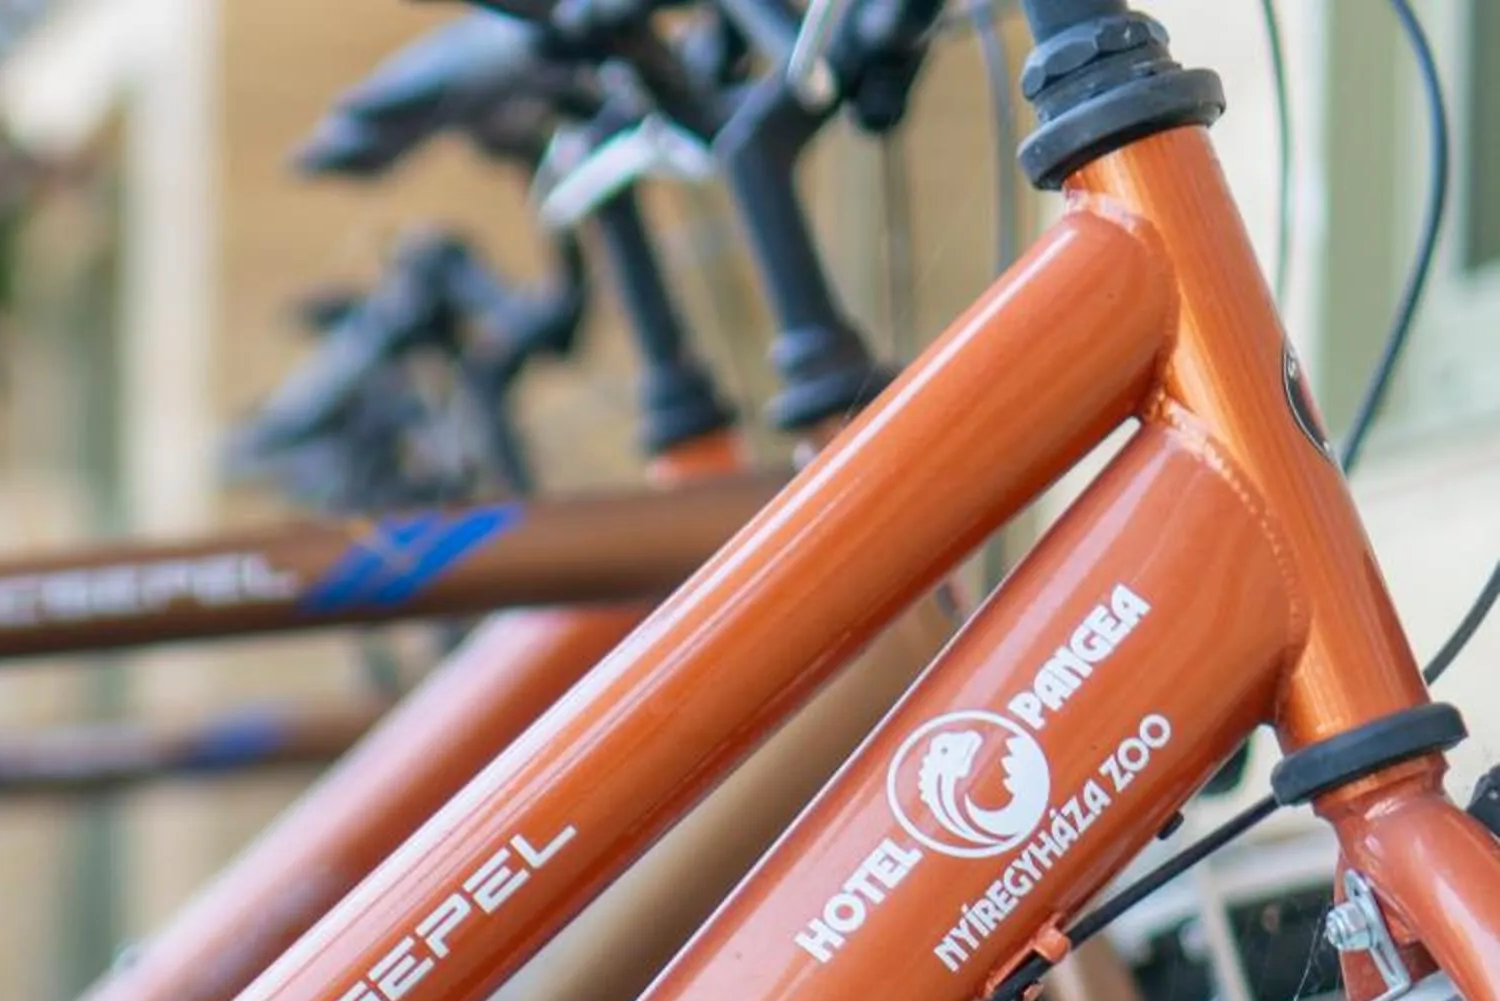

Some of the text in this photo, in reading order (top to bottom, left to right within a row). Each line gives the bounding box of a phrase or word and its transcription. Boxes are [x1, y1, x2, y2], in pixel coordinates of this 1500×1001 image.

[794, 584, 1152, 964] HOTEL PANGEA
[933, 714, 1172, 971] NYÍREGYHÁZA ZOO
